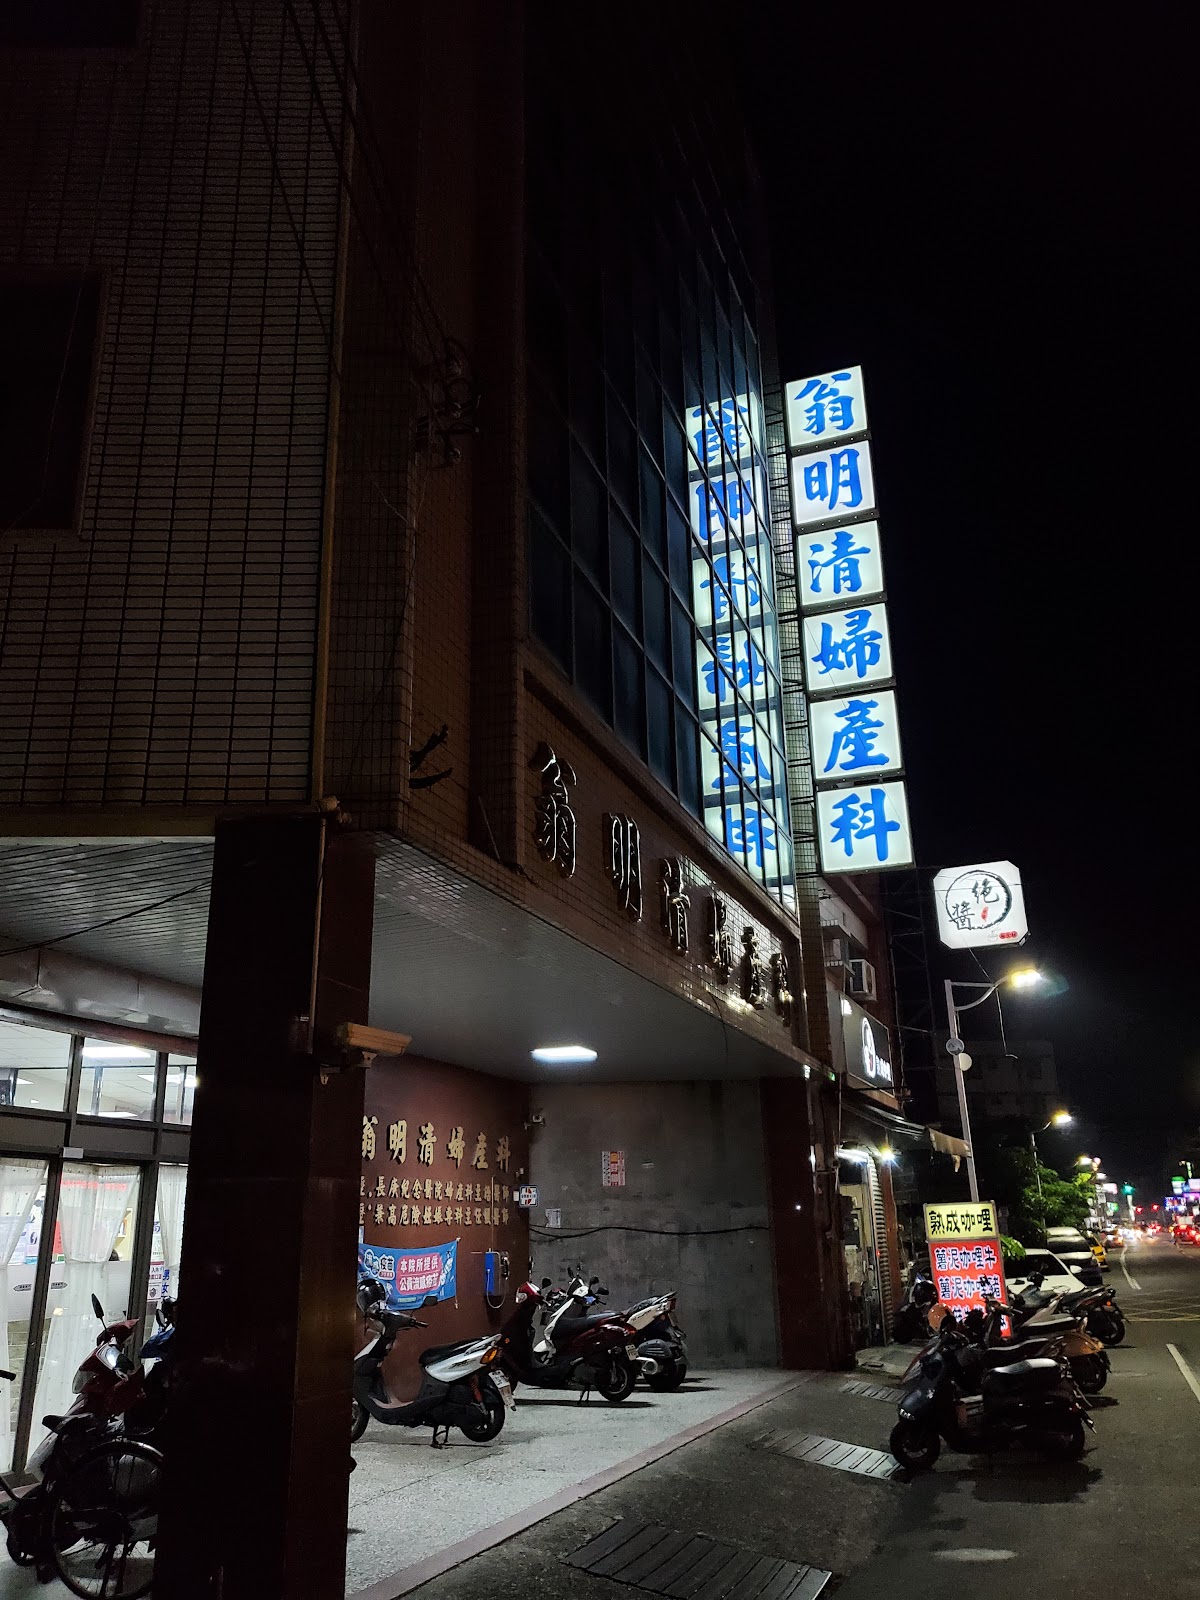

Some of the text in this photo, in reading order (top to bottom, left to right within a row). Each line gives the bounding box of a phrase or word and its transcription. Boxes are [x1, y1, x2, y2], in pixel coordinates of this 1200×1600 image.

[794, 371, 901, 862] 翁明清婦產科
[362, 1115, 511, 1172] 翁明清婦產科
[929, 1208, 993, 1235] 熟成咖哩
[400, 1255, 438, 1273] 本院所提供
[935, 1247, 996, 1270] 薯泥咖哩牛
